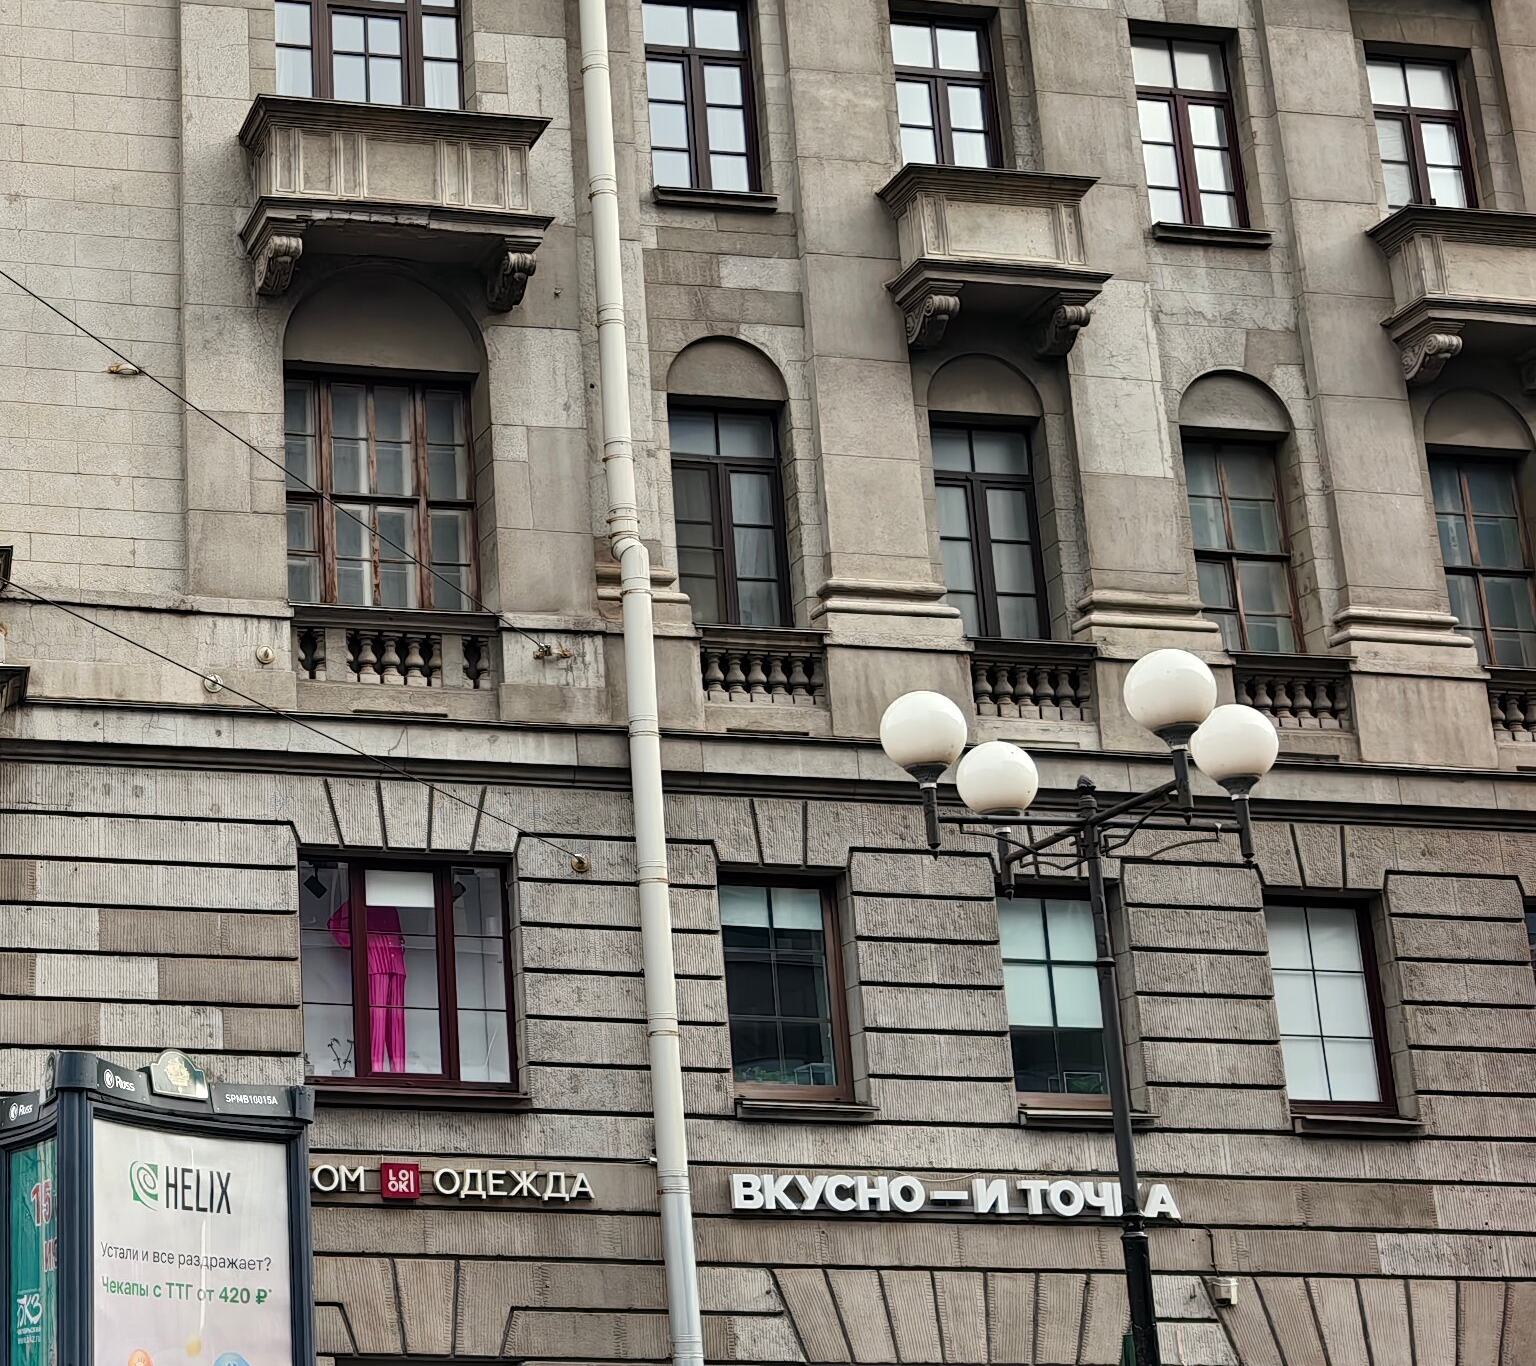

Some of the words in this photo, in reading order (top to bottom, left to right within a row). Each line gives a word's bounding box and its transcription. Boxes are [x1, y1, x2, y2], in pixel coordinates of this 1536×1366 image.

[224, 1093, 278, 1106] SPMB10015A
[165, 1165, 232, 1215] HELIX
[433, 1168, 596, 1202] ОДЕЖДА
[729, 1173, 925, 1214] ВКУСНО
[101, 1241, 139, 1261] Устали
[142, 1251, 149, 1261] и
[152, 1251, 175, 1264] все
[178, 1253, 272, 1272] раздражает?
[101, 1276, 149, 1297] Чекапы
[153, 1285, 162, 1298] с
[165, 1282, 193, 1301] ТТГ
[197, 1288, 214, 1302] от
[218, 1286, 251, 1304] 420
